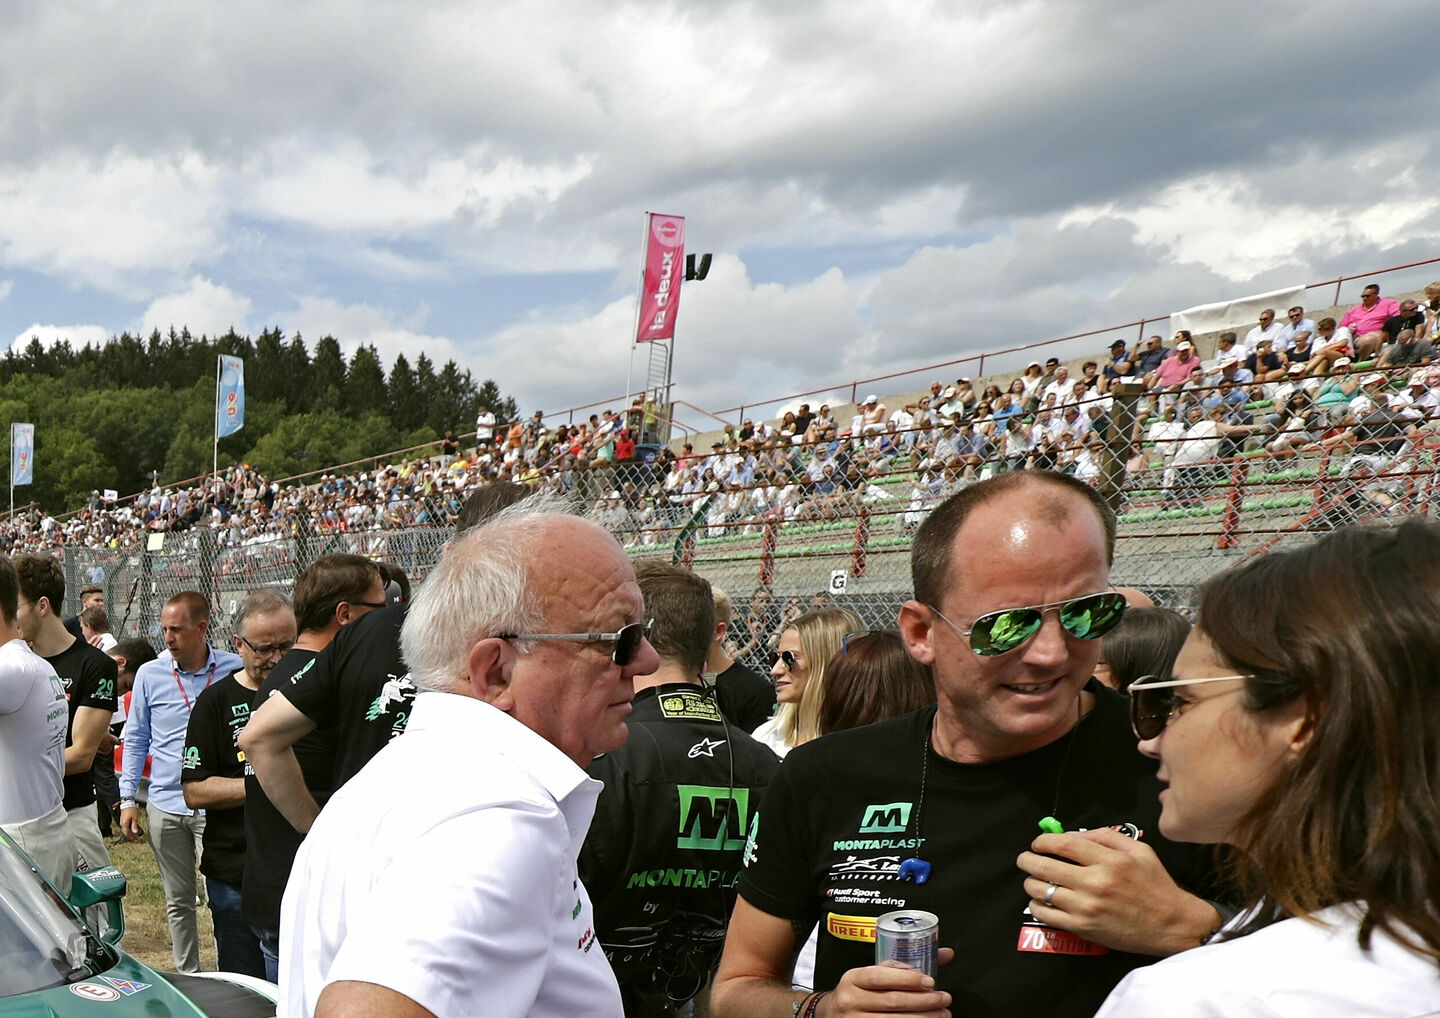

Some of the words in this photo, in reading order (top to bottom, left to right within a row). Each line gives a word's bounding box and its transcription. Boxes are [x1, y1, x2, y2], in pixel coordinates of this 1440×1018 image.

[654, 251, 674, 307] deux
[649, 310, 666, 331] la
[832, 574, 845, 590] G
[833, 838, 926, 851] MONTAPLAST
[833, 888, 852, 896] Audi
[852, 888, 881, 897] Sport
[642, 901, 659, 914] by
[835, 896, 870, 904] customer
[871, 897, 906, 907] racing
[1021, 929, 1045, 950] 70
